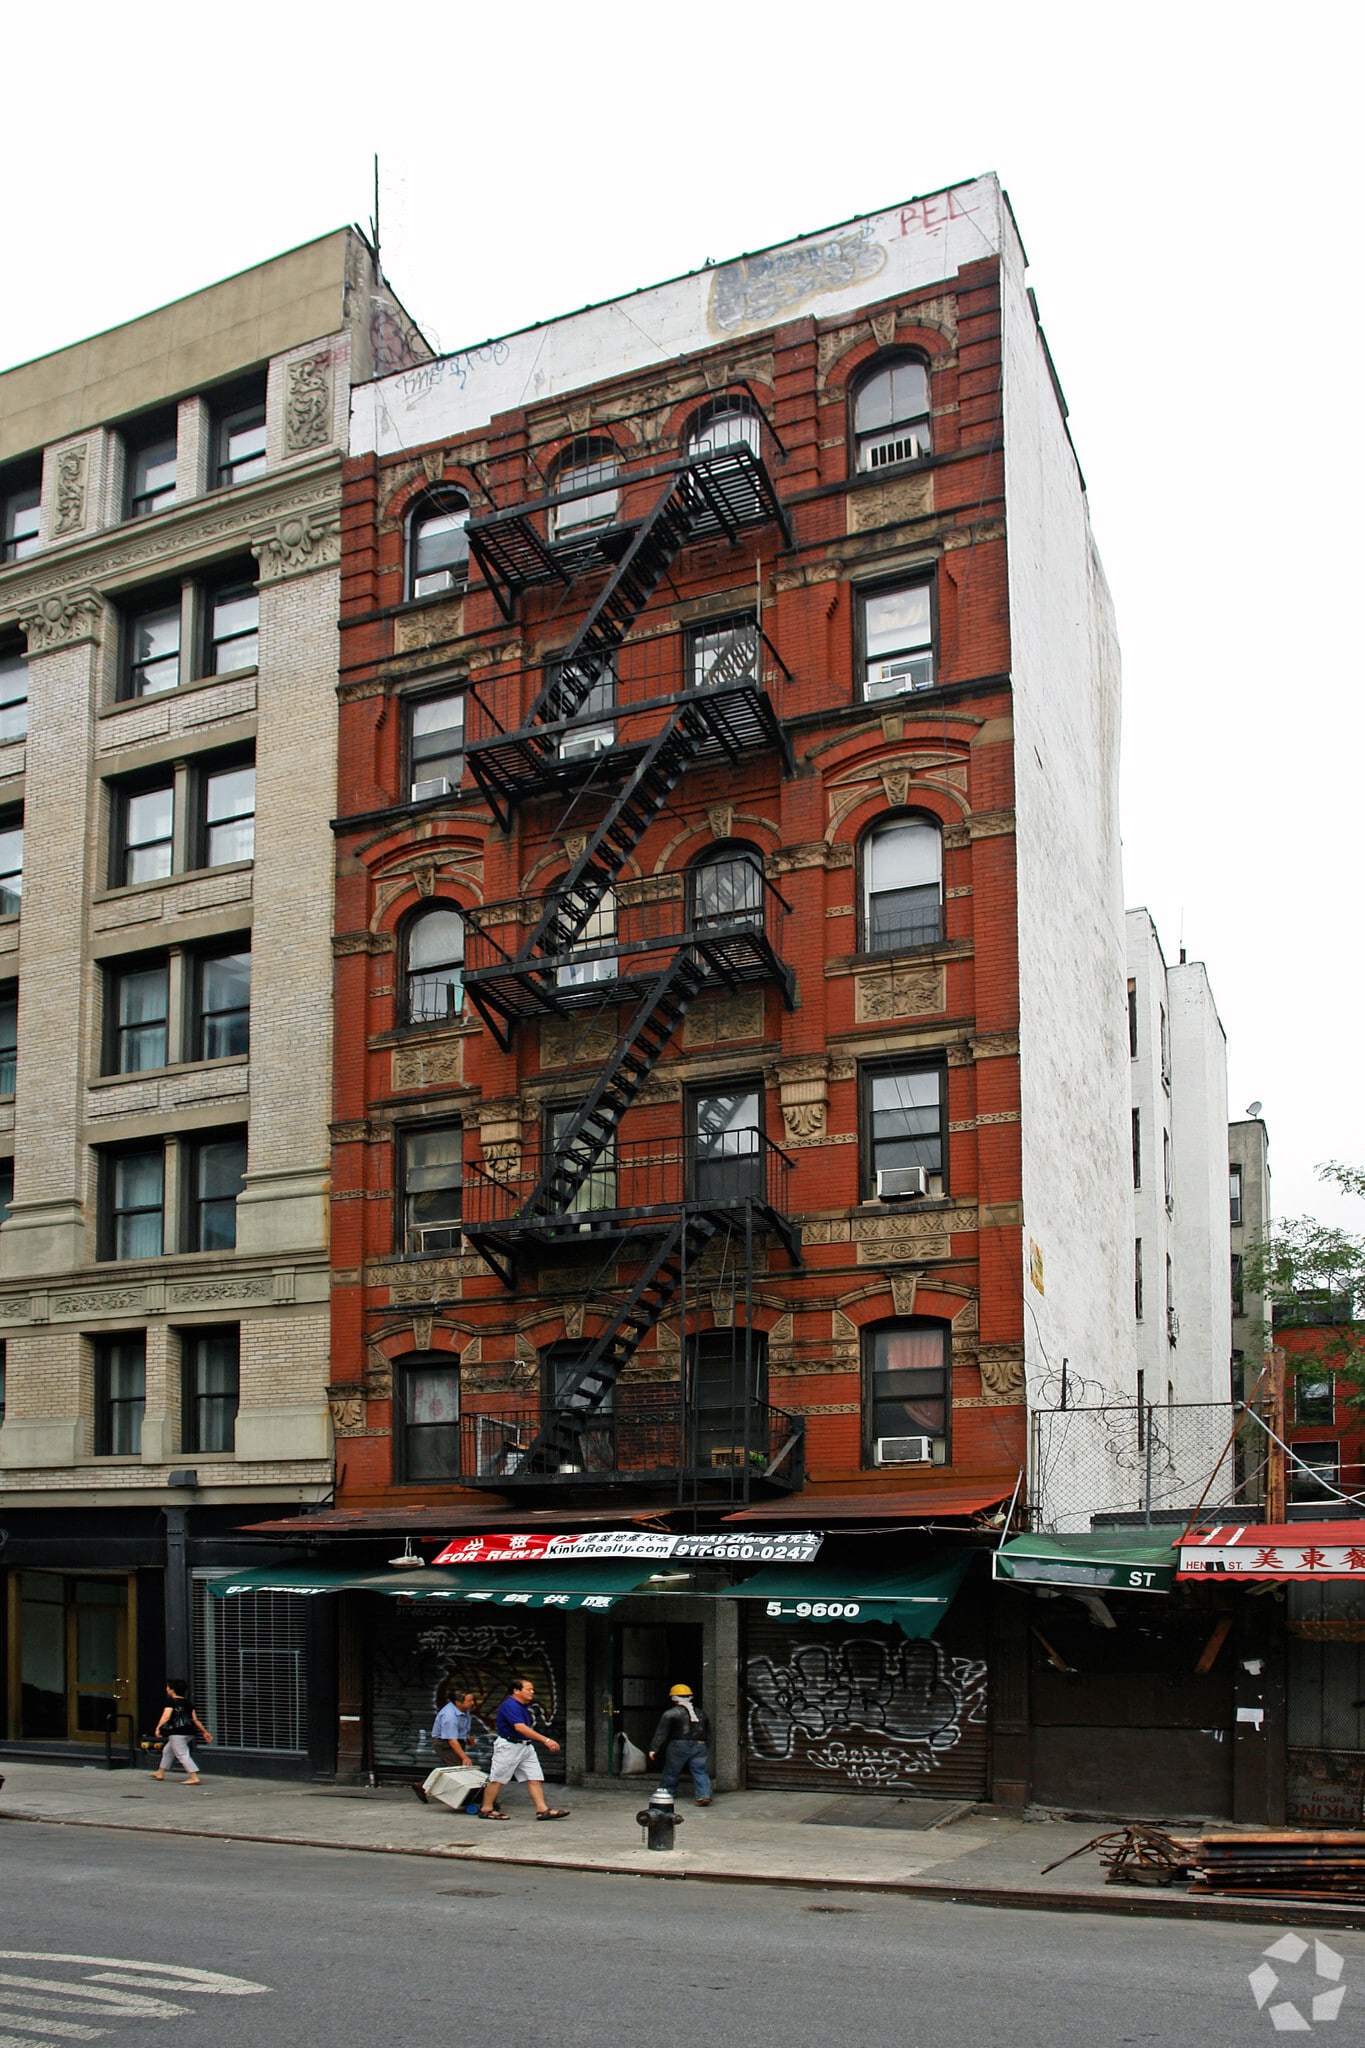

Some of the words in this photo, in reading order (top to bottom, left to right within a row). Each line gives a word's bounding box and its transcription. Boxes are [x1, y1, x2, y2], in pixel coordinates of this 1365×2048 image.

[437, 1551, 478, 1563] FOR
[486, 1548, 544, 1561] RENT
[548, 1543, 668, 1556] KinYuRealty.com
[675, 1544, 814, 1560] 917-660-0247
[1128, 1570, 1157, 1588] ST
[766, 1601, 860, 1617] 5-9600
